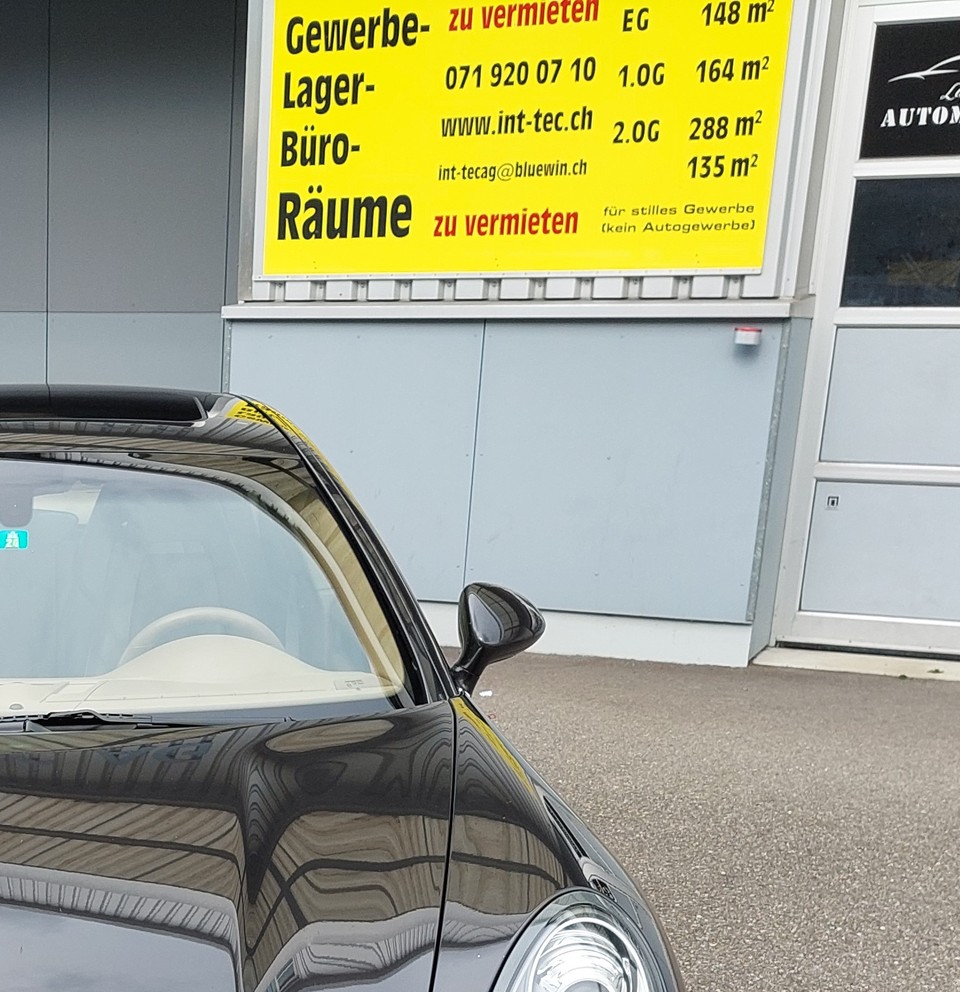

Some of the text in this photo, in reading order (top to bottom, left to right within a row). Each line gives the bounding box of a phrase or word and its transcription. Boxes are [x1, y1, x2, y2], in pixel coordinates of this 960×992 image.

[449, 0, 599, 31] zu vermieten
[622, 7, 649, 32] EG
[701, 0, 741, 27] 148
[286, 7, 431, 55] Gewerbe-
[445, 56, 596, 90] 071 920 07 10
[696, 58, 735, 83] 164
[283, 72, 375, 115] Lager-
[441, 105, 593, 137] www.int-tec.ch
[689, 116, 729, 141] 288
[280, 124, 361, 167] Büro-
[438, 159, 588, 182] int-tecag@bluewin.ch
[687, 155, 725, 179] 135
[277, 184, 413, 241] Räume
[433, 207, 579, 237] zu vermieten
[603, 203, 755, 217] für stilles Gewerbe
[601, 219, 756, 234] (kein Autogewerbe)
